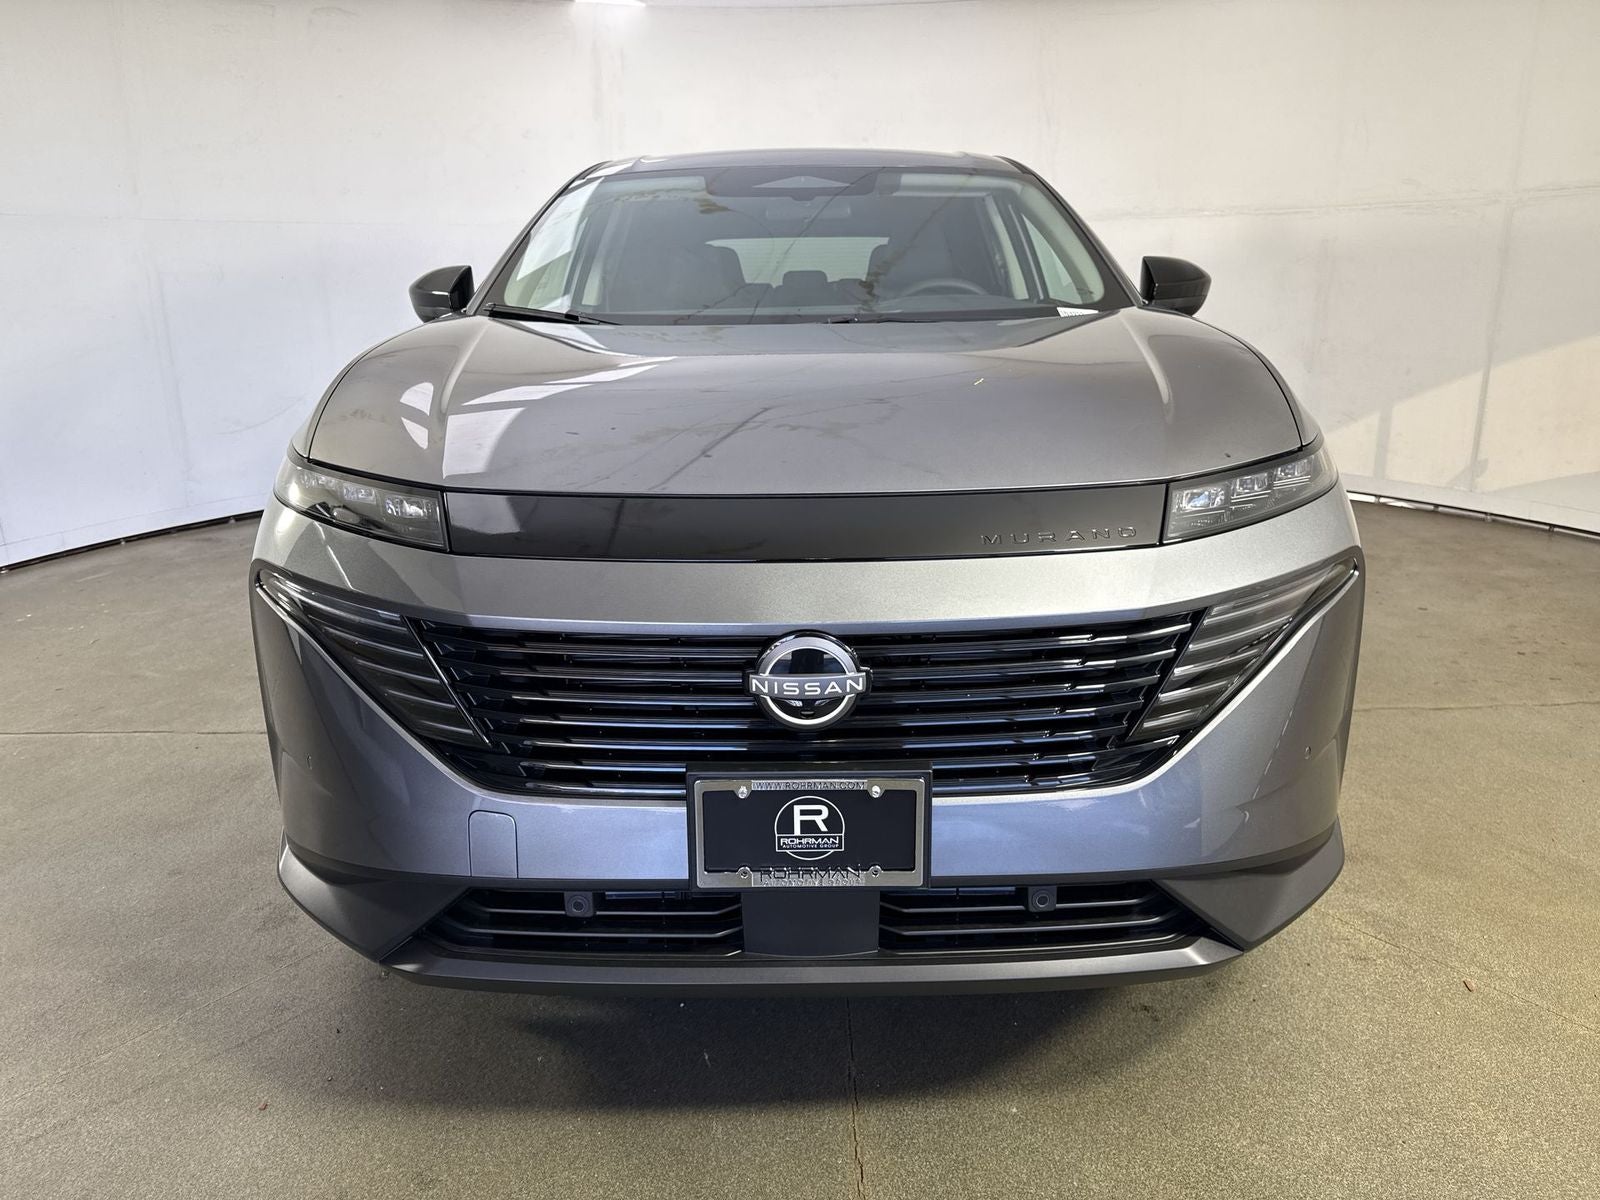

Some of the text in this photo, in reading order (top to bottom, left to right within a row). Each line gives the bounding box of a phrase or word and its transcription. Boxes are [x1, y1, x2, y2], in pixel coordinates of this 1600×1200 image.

[980, 526, 1137, 545] MURANO
[751, 677, 864, 695] NISSAN
[793, 804, 829, 835] R
[780, 836, 839, 846] ROHRMAN
[760, 863, 862, 881] ROHRMAN
